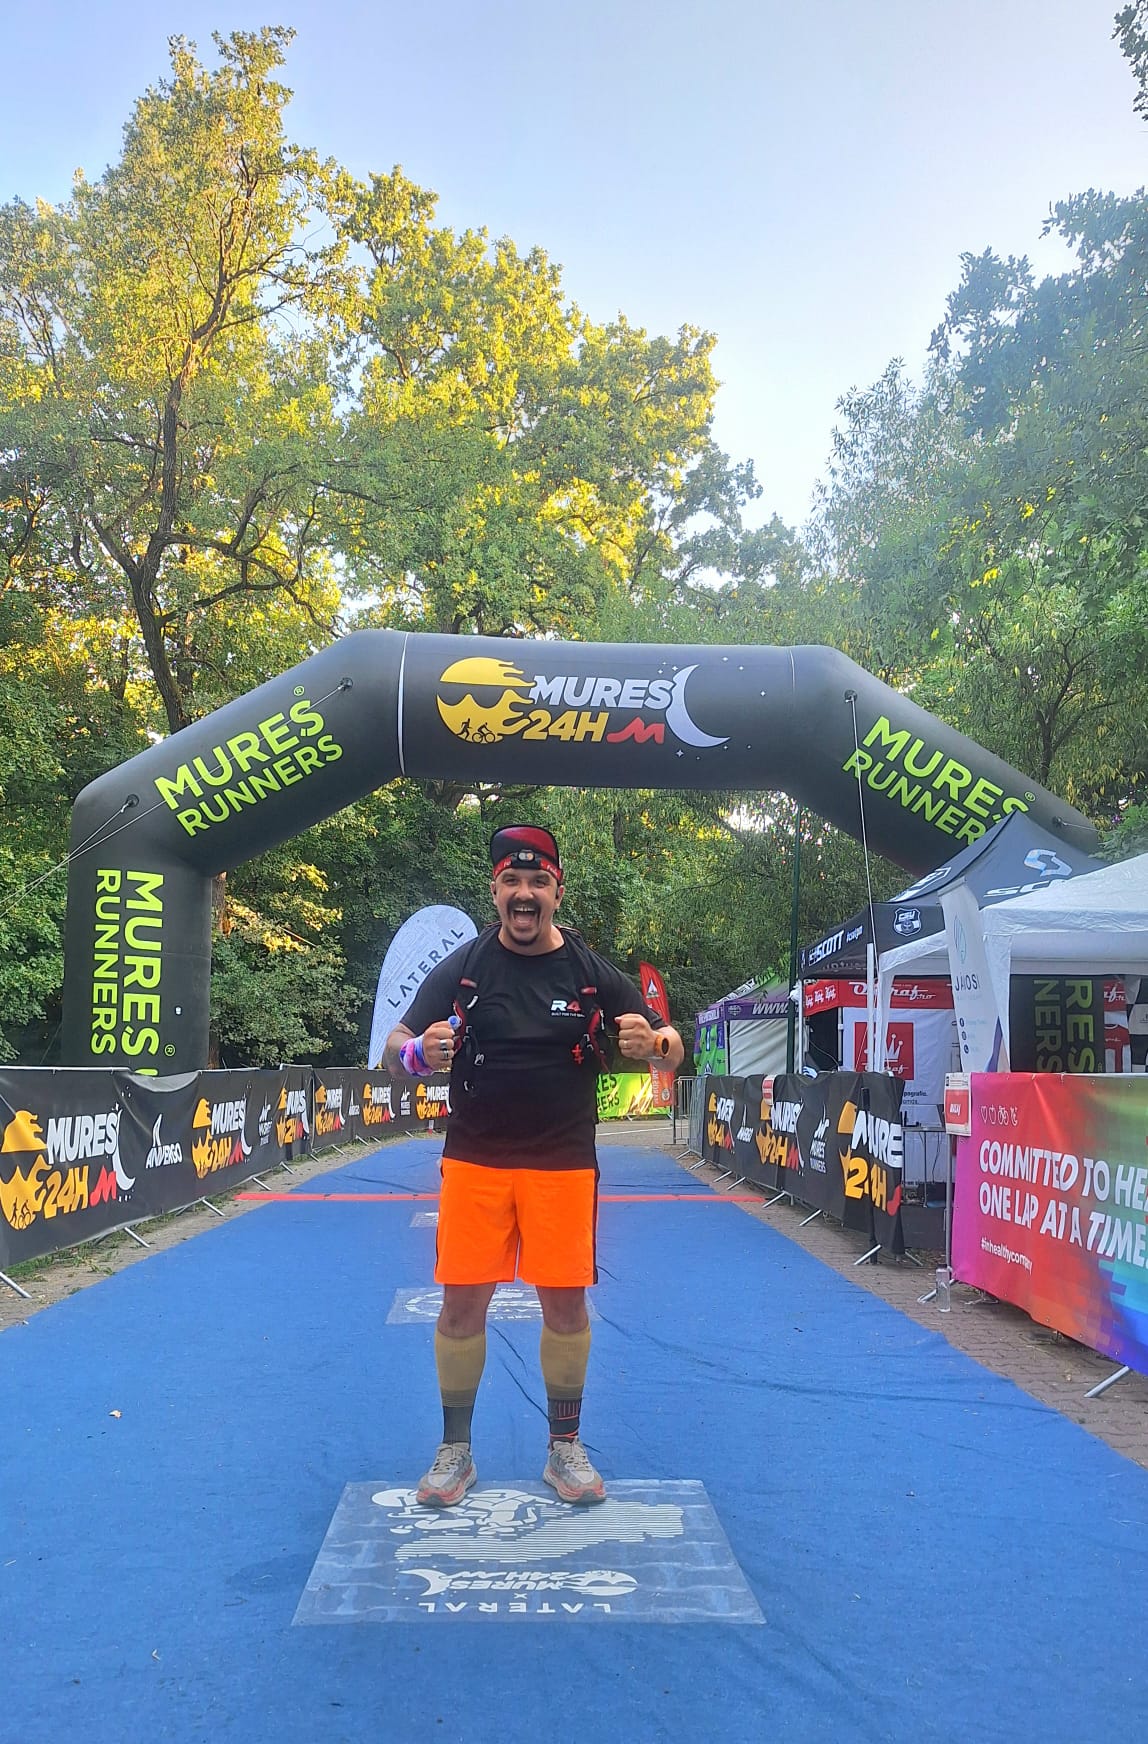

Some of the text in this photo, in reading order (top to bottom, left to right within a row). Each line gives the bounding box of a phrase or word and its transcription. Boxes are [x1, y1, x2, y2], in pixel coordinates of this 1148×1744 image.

[522, 710, 610, 742] 24H
[529, 675, 674, 710] MURES
[154, 699, 325, 810] MURES
[176, 735, 343, 837] RUNNERS
[842, 748, 986, 846] RUNNER
[91, 869, 121, 1054] RUNNERS
[121, 871, 165, 1056] MURES
[388, 929, 464, 1008] LATERAL
[1033, 980, 1063, 1072] NERS
[1065, 980, 1095, 1072] RES
[46, 1112, 118, 1165] MURES
[211, 1098, 244, 1136] MURES
[851, 1110, 903, 1168] MURE
[209, 1136, 232, 1172] 24H
[979, 1139, 1148, 1212] COMMITTED TO HE
[43, 1165, 90, 1220] 24H
[979, 1181, 1012, 1222] ONE
[1014, 1189, 1039, 1229] LAP
[1039, 1199, 1068, 1240] AT
[1069, 1206, 1083, 1248] A
[418, 1602, 611, 1613] LATERAL
